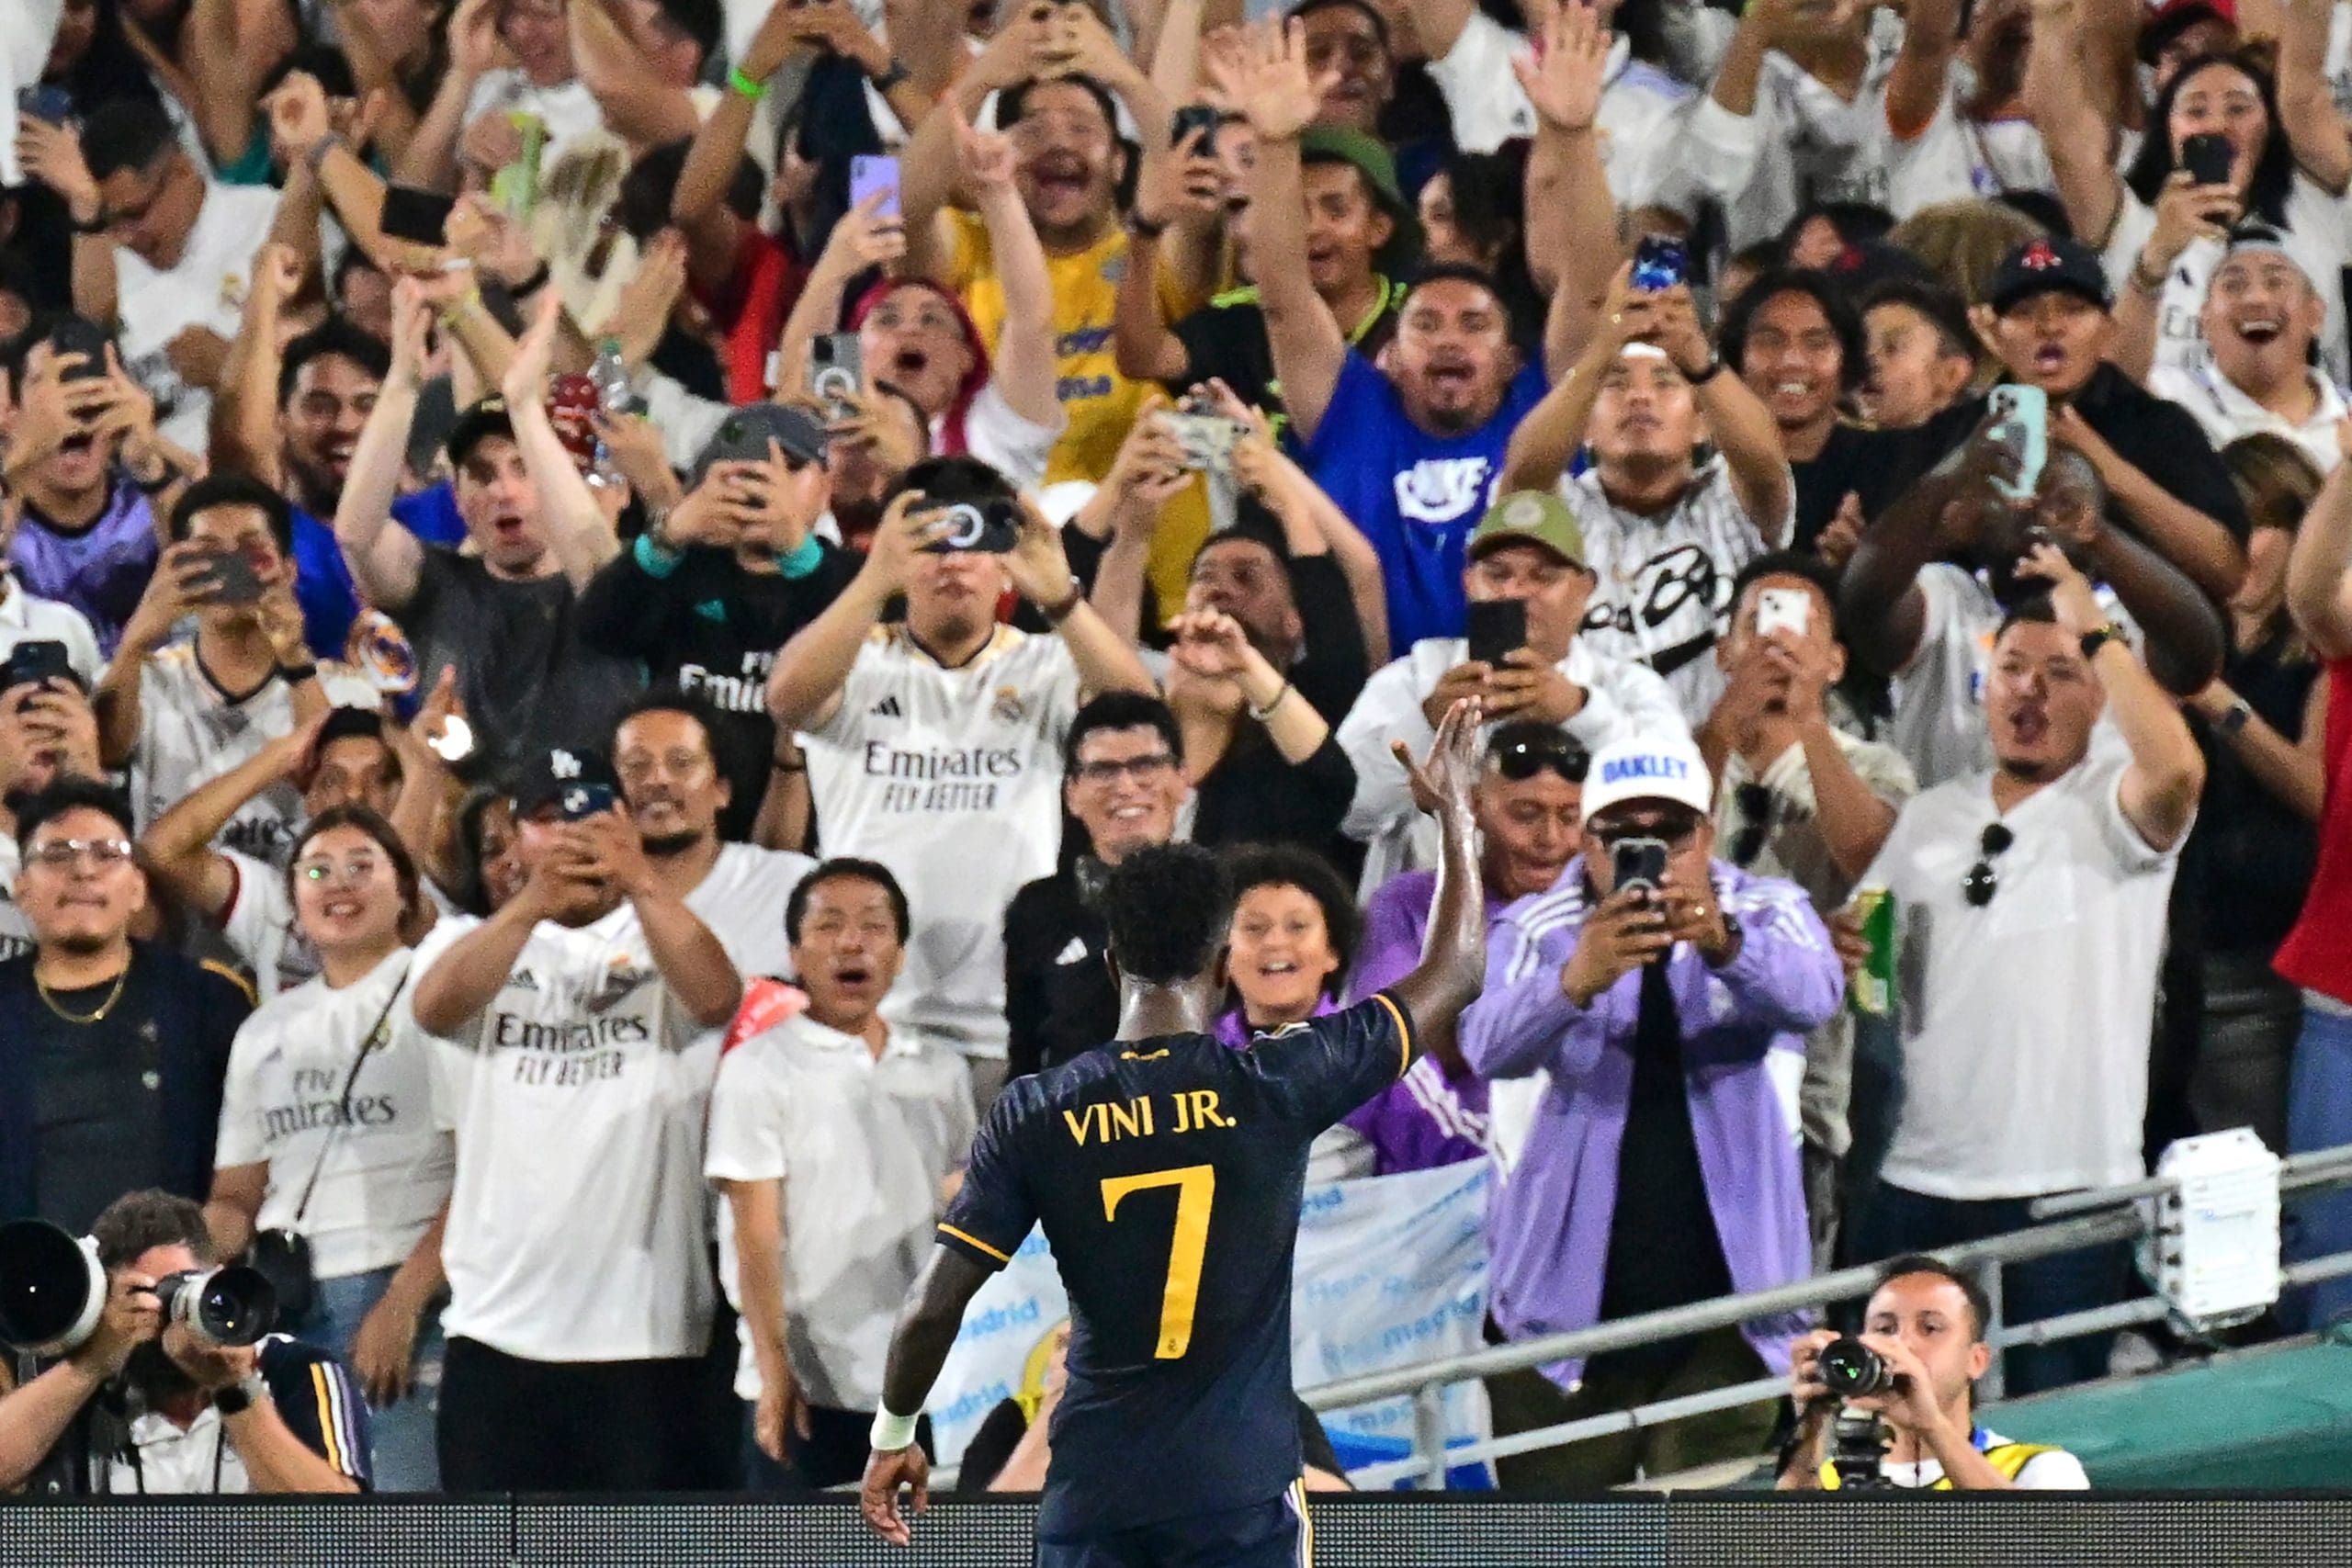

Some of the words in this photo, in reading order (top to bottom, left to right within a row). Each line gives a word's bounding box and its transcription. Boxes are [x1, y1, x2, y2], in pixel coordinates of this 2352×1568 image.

[865, 739, 1022, 779] Emirates
[1602, 754, 1689, 784] OAKLEY
[495, 1012, 649, 1054] Emirates
[1062, 1095, 1154, 1147] VINI
[1171, 1089, 1237, 1134] JR.
[1101, 1164, 1216, 1359] 7
